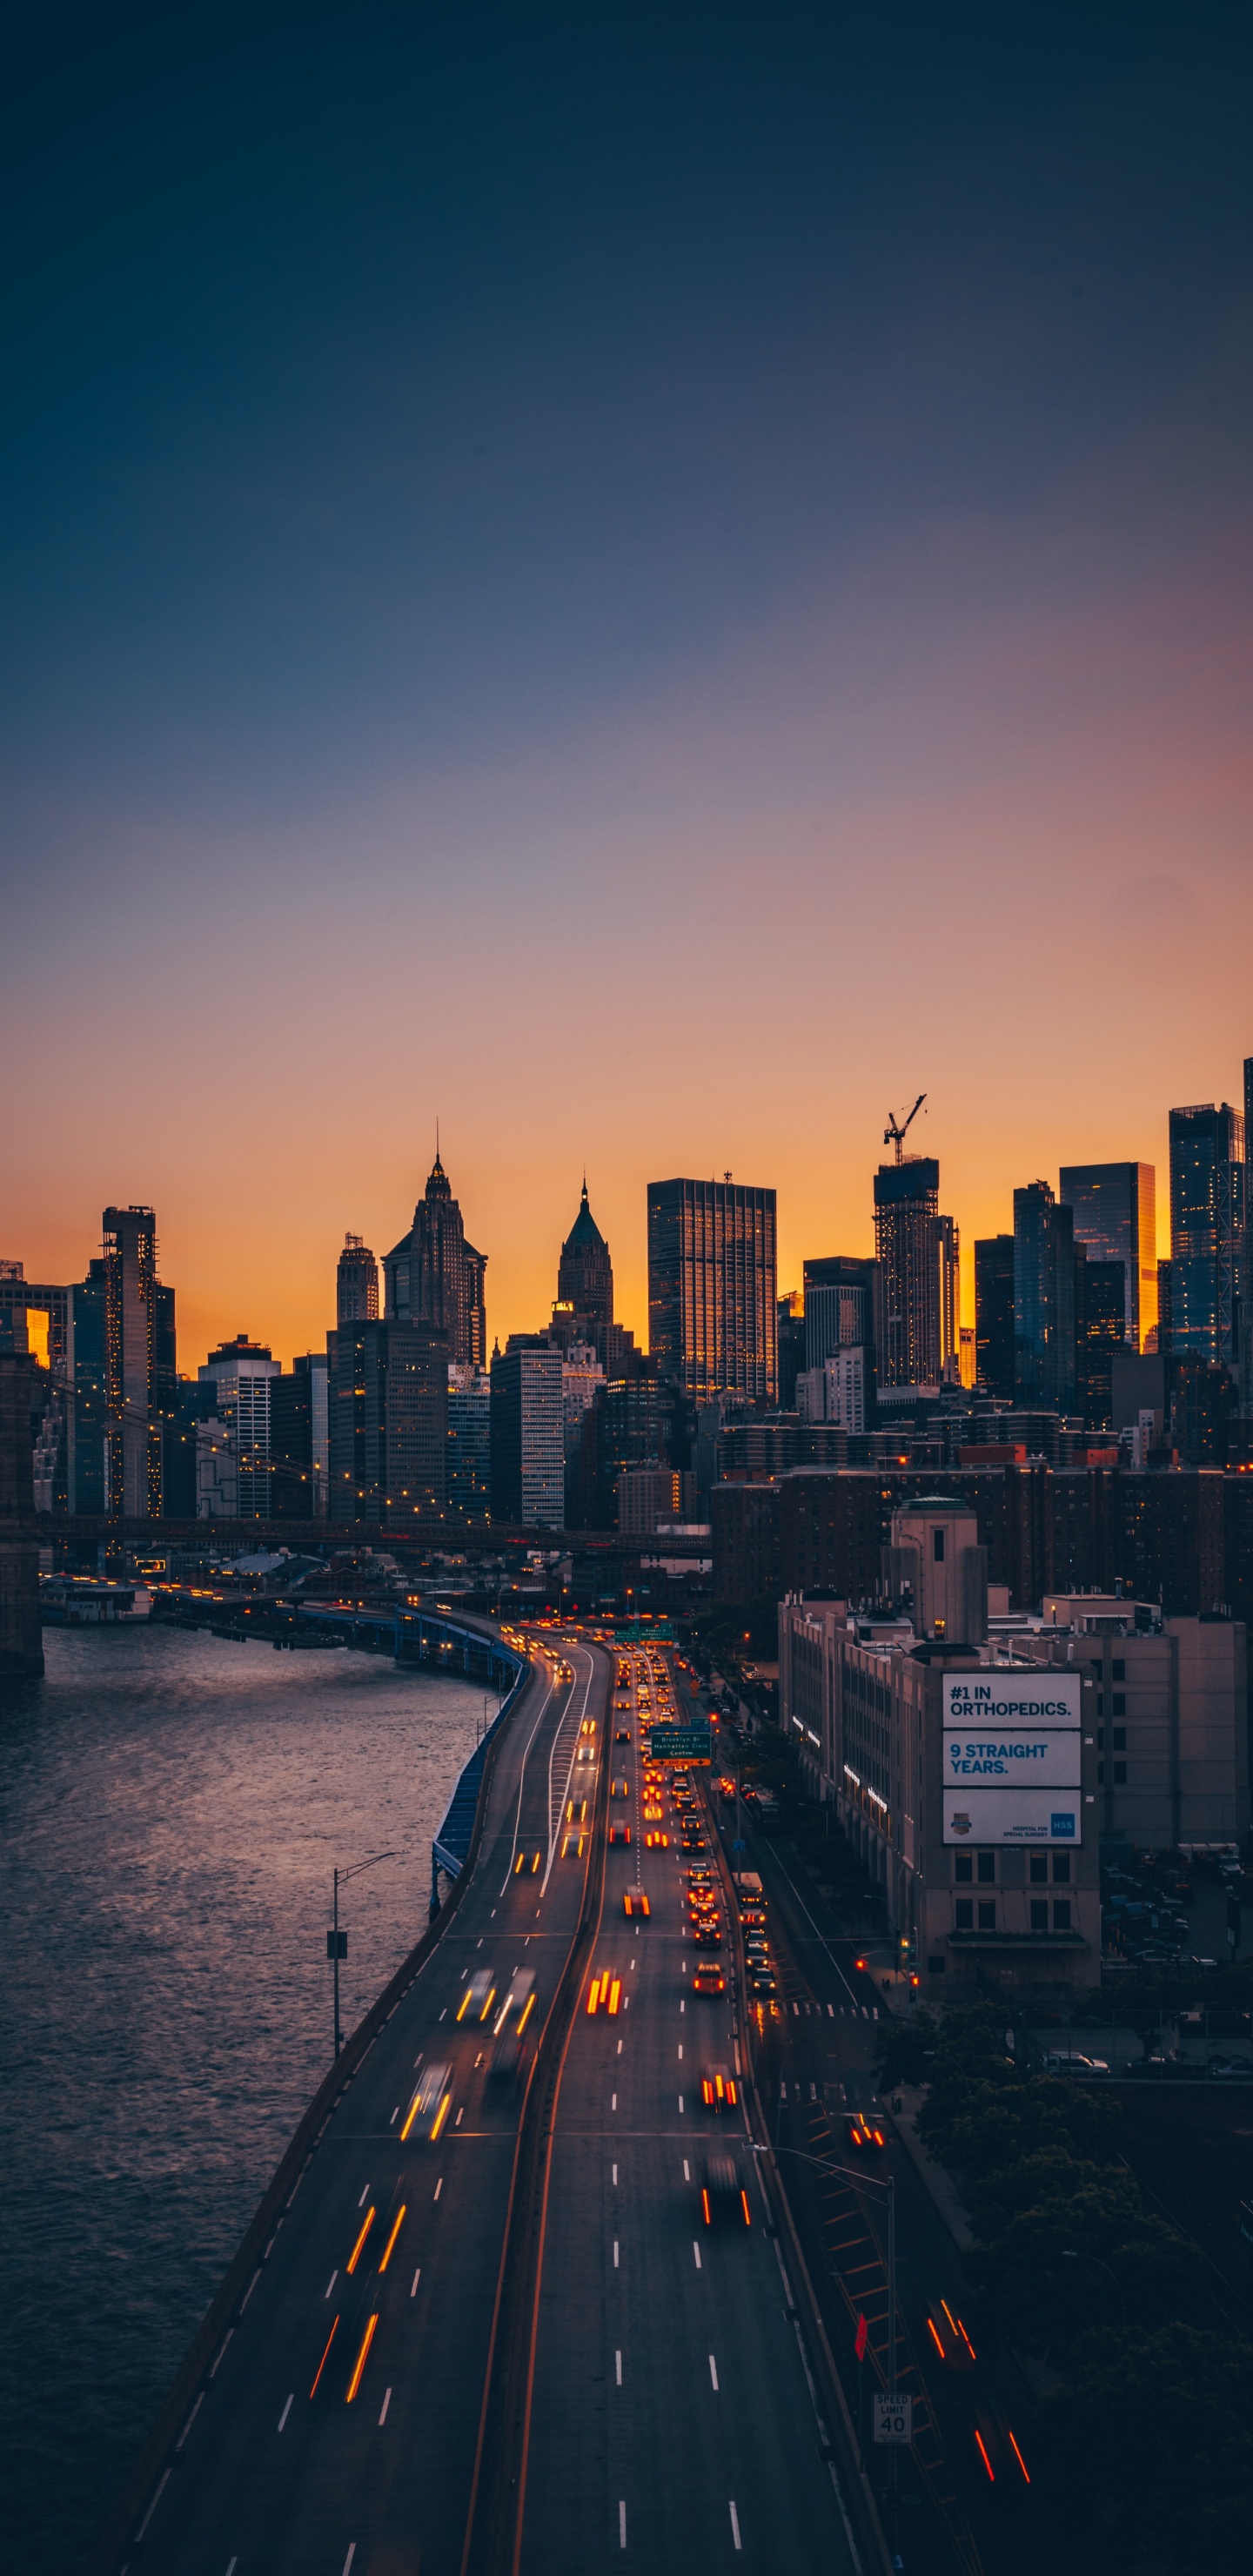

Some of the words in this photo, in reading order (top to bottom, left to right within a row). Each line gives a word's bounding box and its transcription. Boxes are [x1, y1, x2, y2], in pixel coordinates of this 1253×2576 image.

[950, 1687, 970, 1700] #1
[975, 1687, 991, 1700] IN
[950, 1702, 1071, 1716] ORTHOPEDICS.
[950, 1744, 961, 1758] 9
[965, 1744, 1049, 1758] STRAIGHT
[950, 1760, 1008, 1774] YEARS.
[877, 2395, 908, 2404] SPEED
[881, 2405, 904, 2414] LIMIT
[881, 2417, 905, 2432] 40
